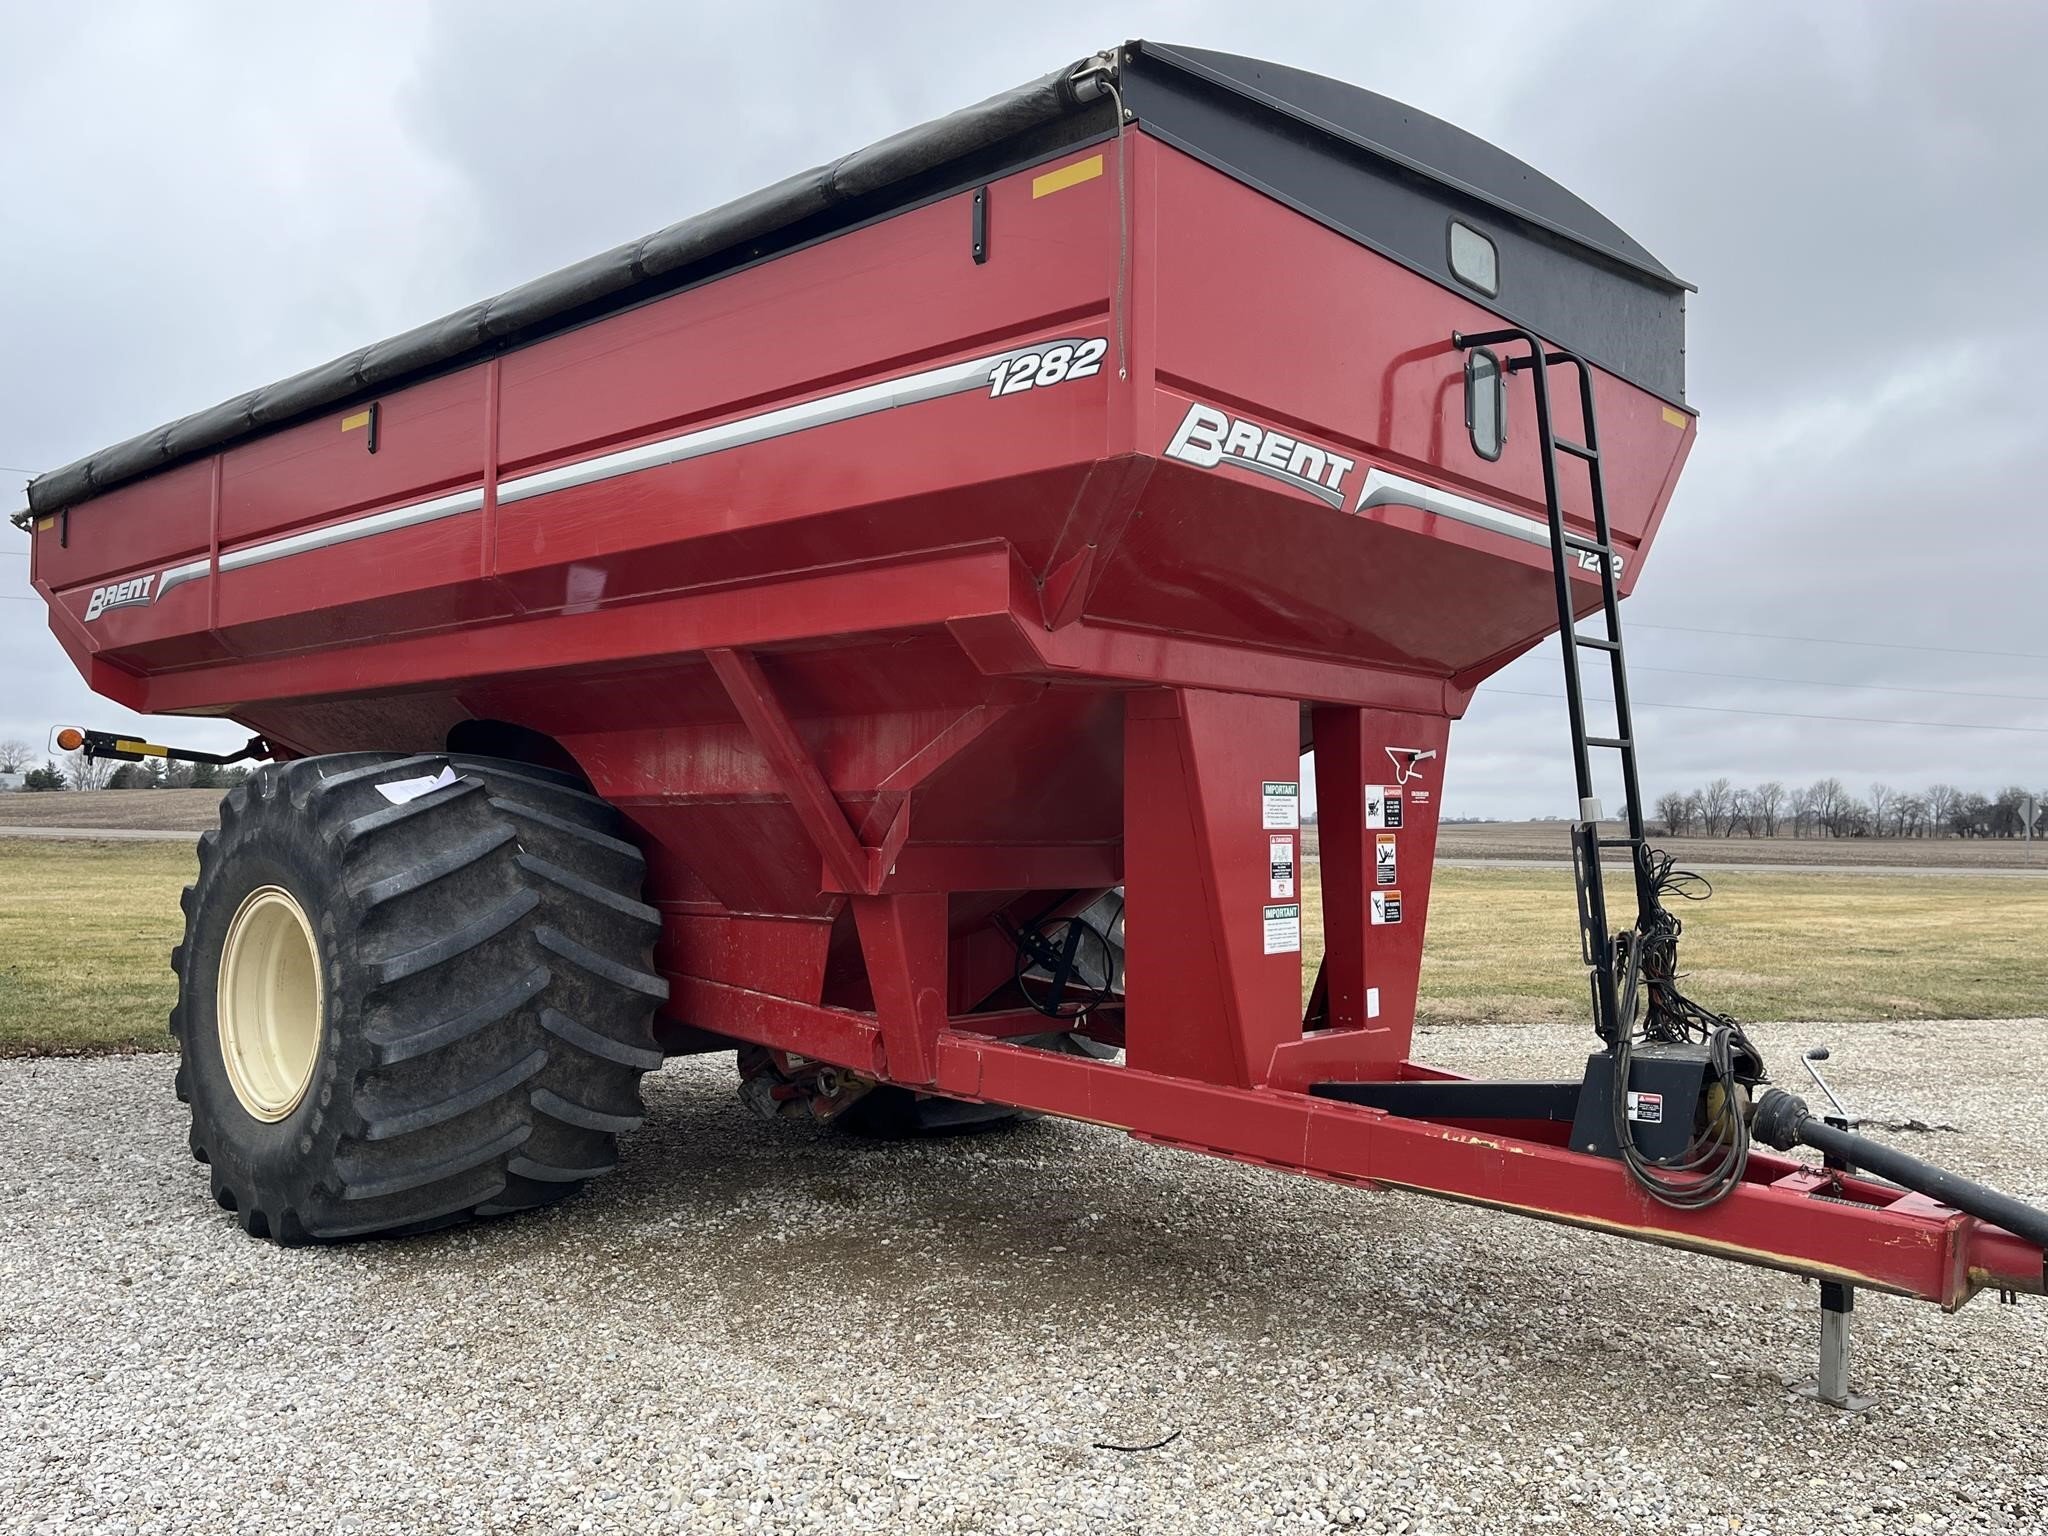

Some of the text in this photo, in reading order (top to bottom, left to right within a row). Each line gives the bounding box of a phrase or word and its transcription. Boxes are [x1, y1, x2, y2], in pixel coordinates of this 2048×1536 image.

[987, 337, 1109, 399] 1282
[1164, 401, 1355, 493] BRENT
[1577, 549, 1624, 580] 122
[84, 574, 156, 622] BRENT
[1265, 784, 1296, 795] IMPORTANT
[1265, 907, 1297, 919] IMPORTANT
